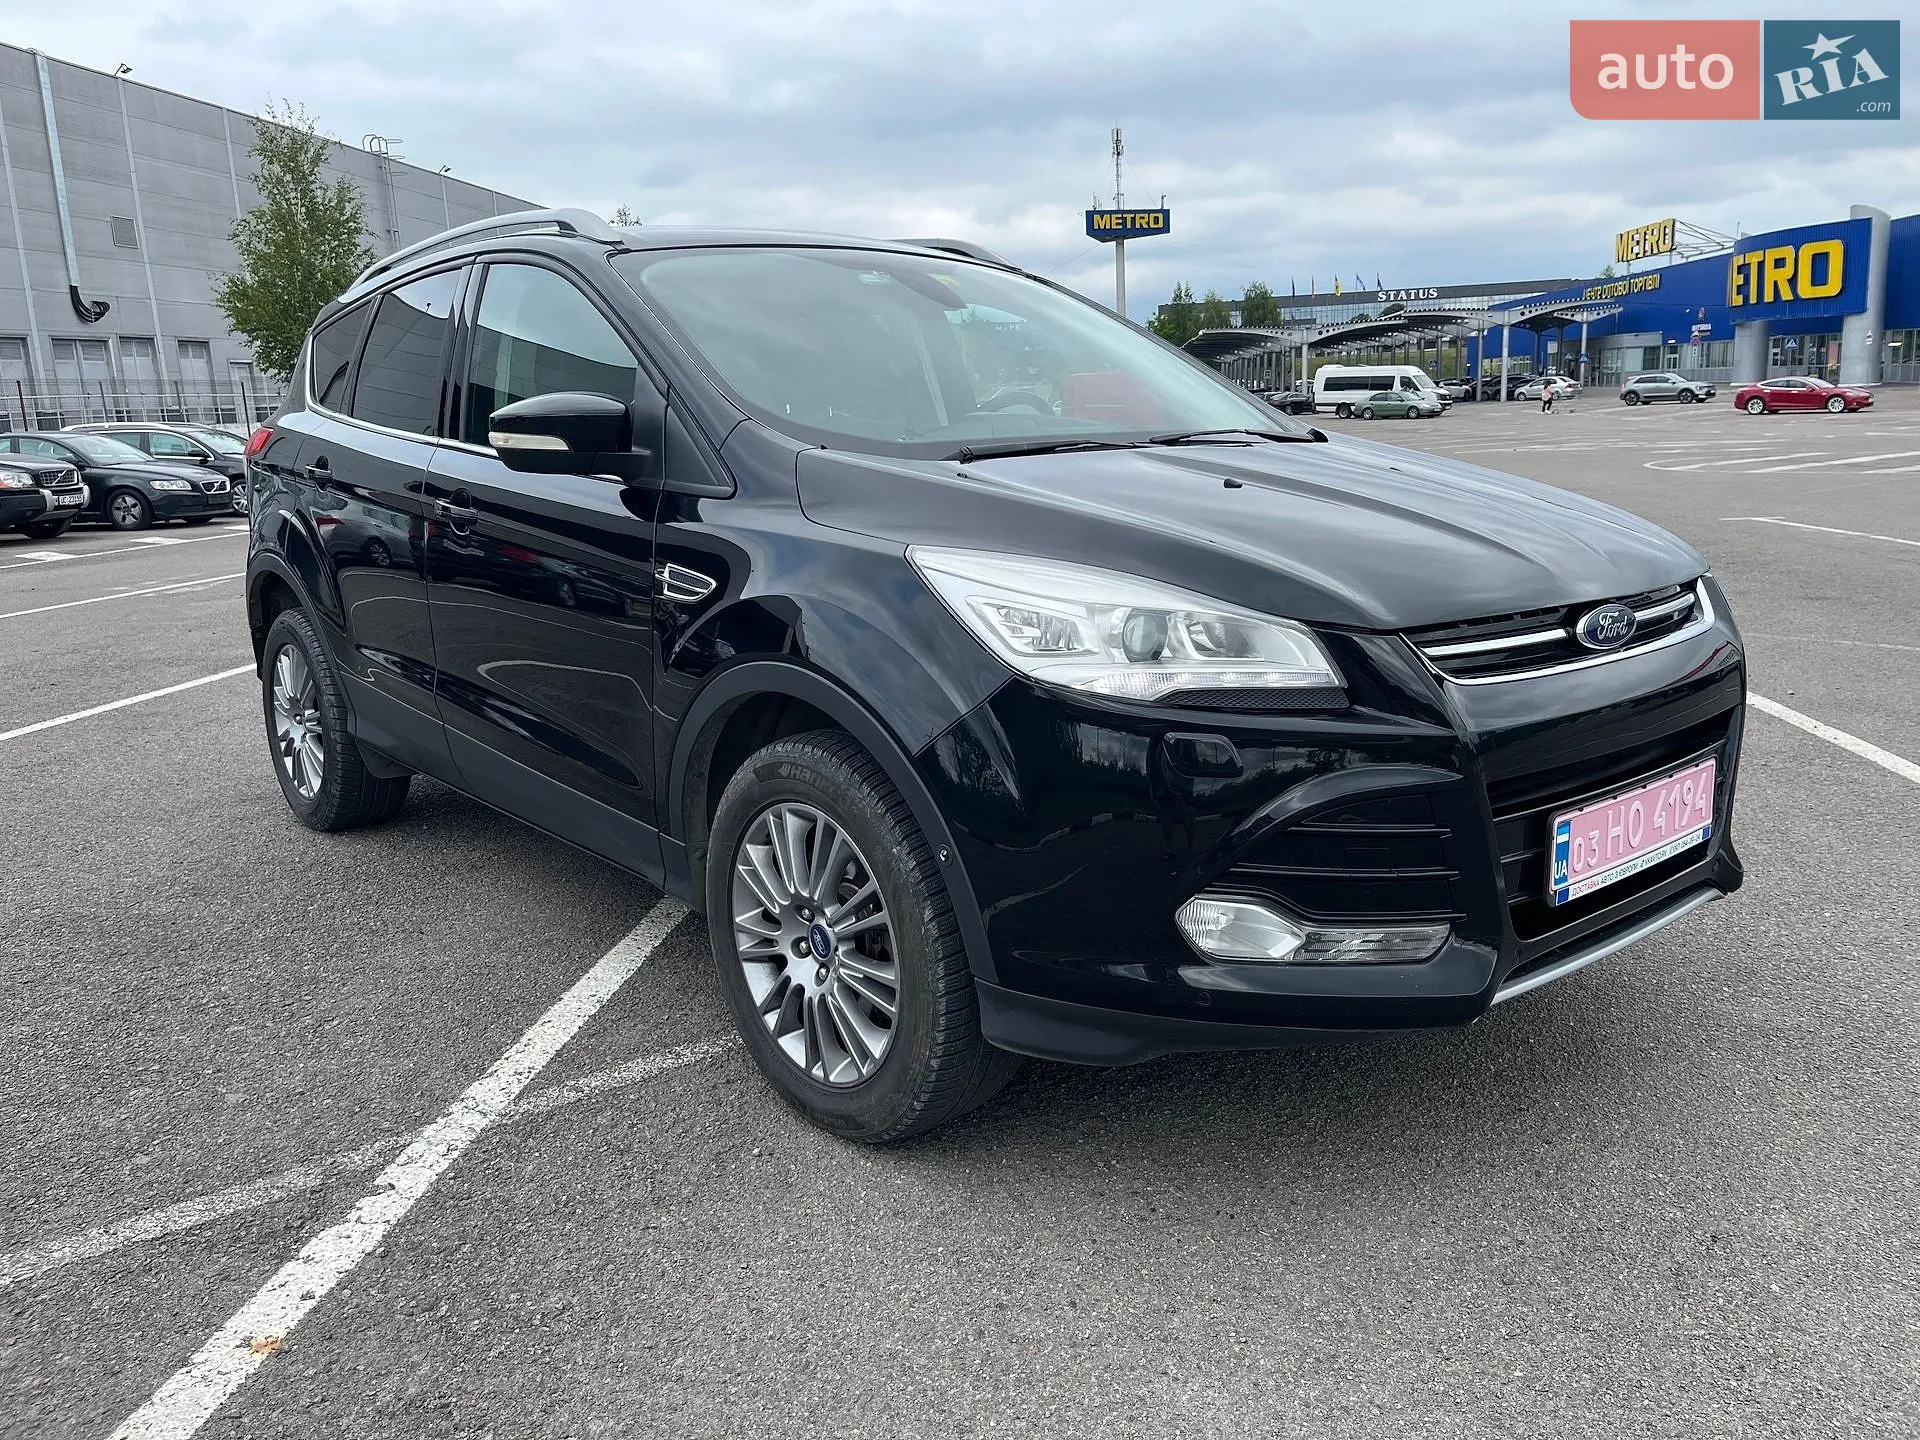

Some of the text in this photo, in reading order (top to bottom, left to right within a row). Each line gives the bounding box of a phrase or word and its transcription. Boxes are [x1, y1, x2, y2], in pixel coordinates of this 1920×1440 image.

[1093, 213, 1164, 229] METRO
[1615, 217, 1675, 263] METRO
[1727, 239, 1844, 308] ETRO
[1377, 288, 1439, 302] STATUS
[1597, 611, 1629, 640] Ford
[1572, 772, 1708, 873] 03 HO 4194
[1554, 860, 1569, 879] UA
